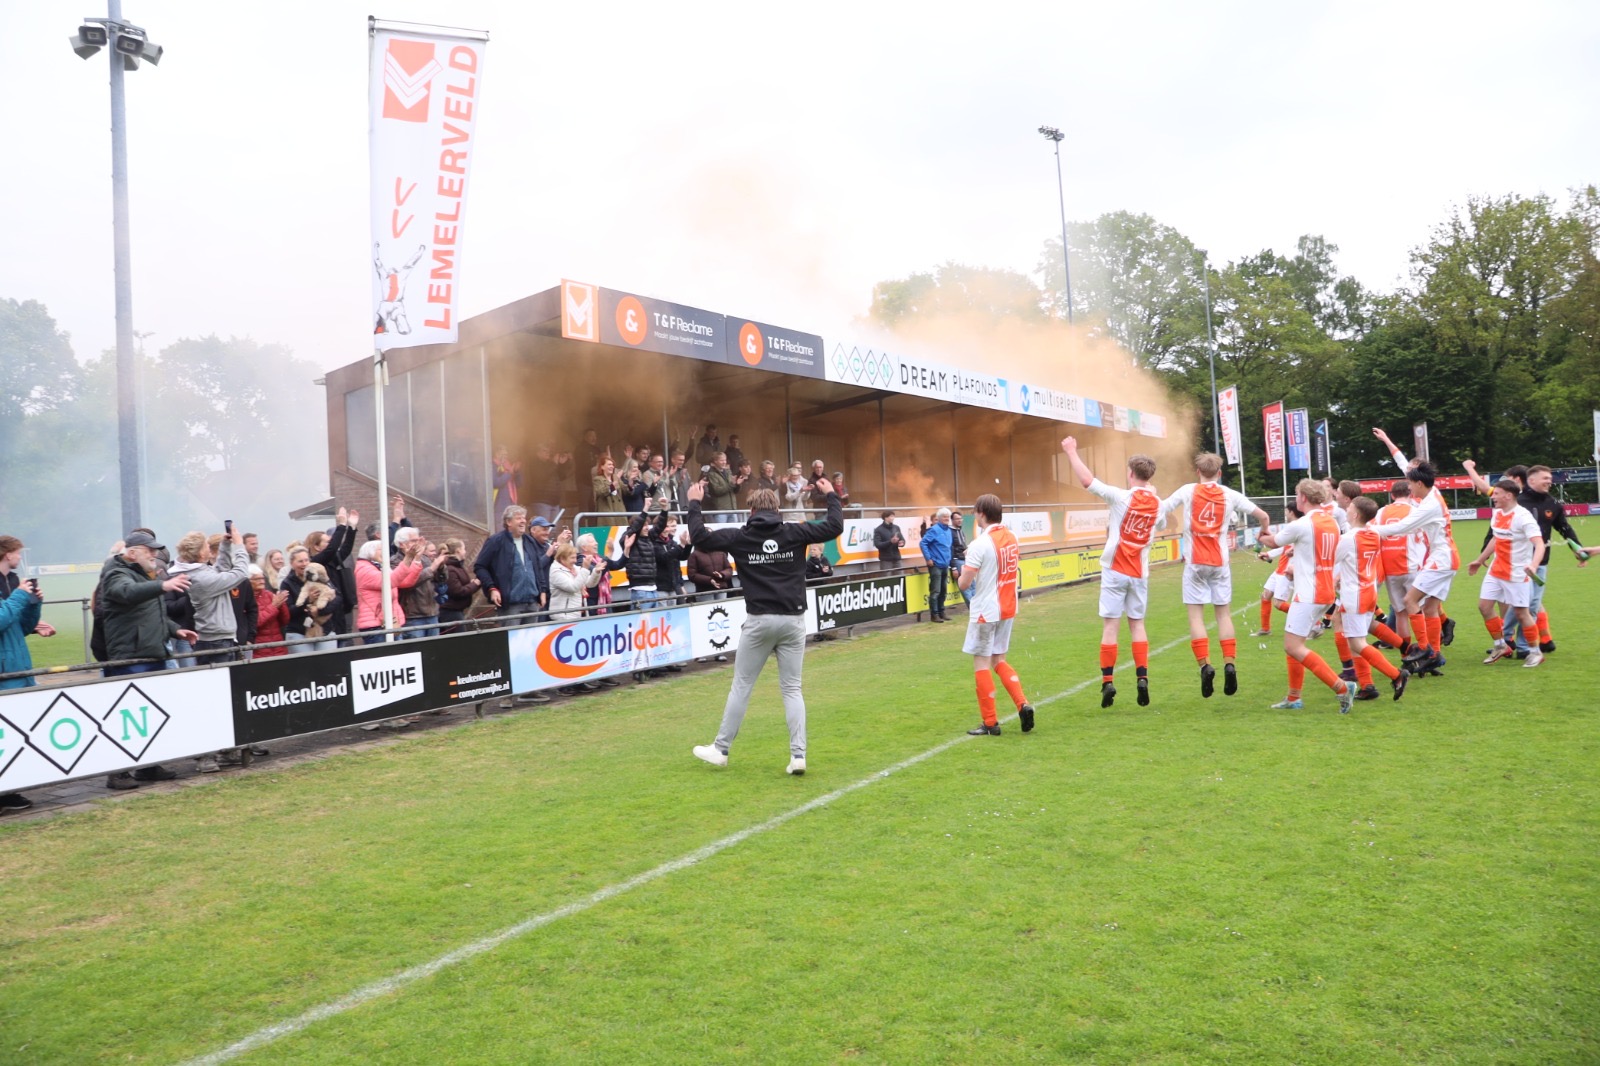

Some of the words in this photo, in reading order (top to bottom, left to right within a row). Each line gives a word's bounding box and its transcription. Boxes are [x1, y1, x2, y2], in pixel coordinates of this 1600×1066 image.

[424, 45, 478, 330] LEMELERVELD
[677, 317, 713, 337] Reclame
[785, 340, 814, 356] Reclame
[836, 353, 892, 380] ACON
[900, 363, 948, 393] DREAM
[953, 374, 998, 397] PLAFONDS
[1034, 390, 1078, 412] multiselect
[1124, 510, 1151, 538] 14
[1198, 502, 1216, 528] 4
[1449, 509, 1476, 517] NKAMP
[748, 551, 794, 561] Wagenmans
[1000, 544, 1018, 574] 15
[1322, 532, 1335, 560] 11
[1363, 551, 1376, 577] 7
[817, 577, 905, 617] voetbalshop.nl
[708, 619, 730, 632] CNC
[554, 615, 673, 664] Combidak
[245, 677, 348, 712] keukenland
[360, 667, 417, 693] WIJHE
[456, 668, 502, 686] keukenland.nl
